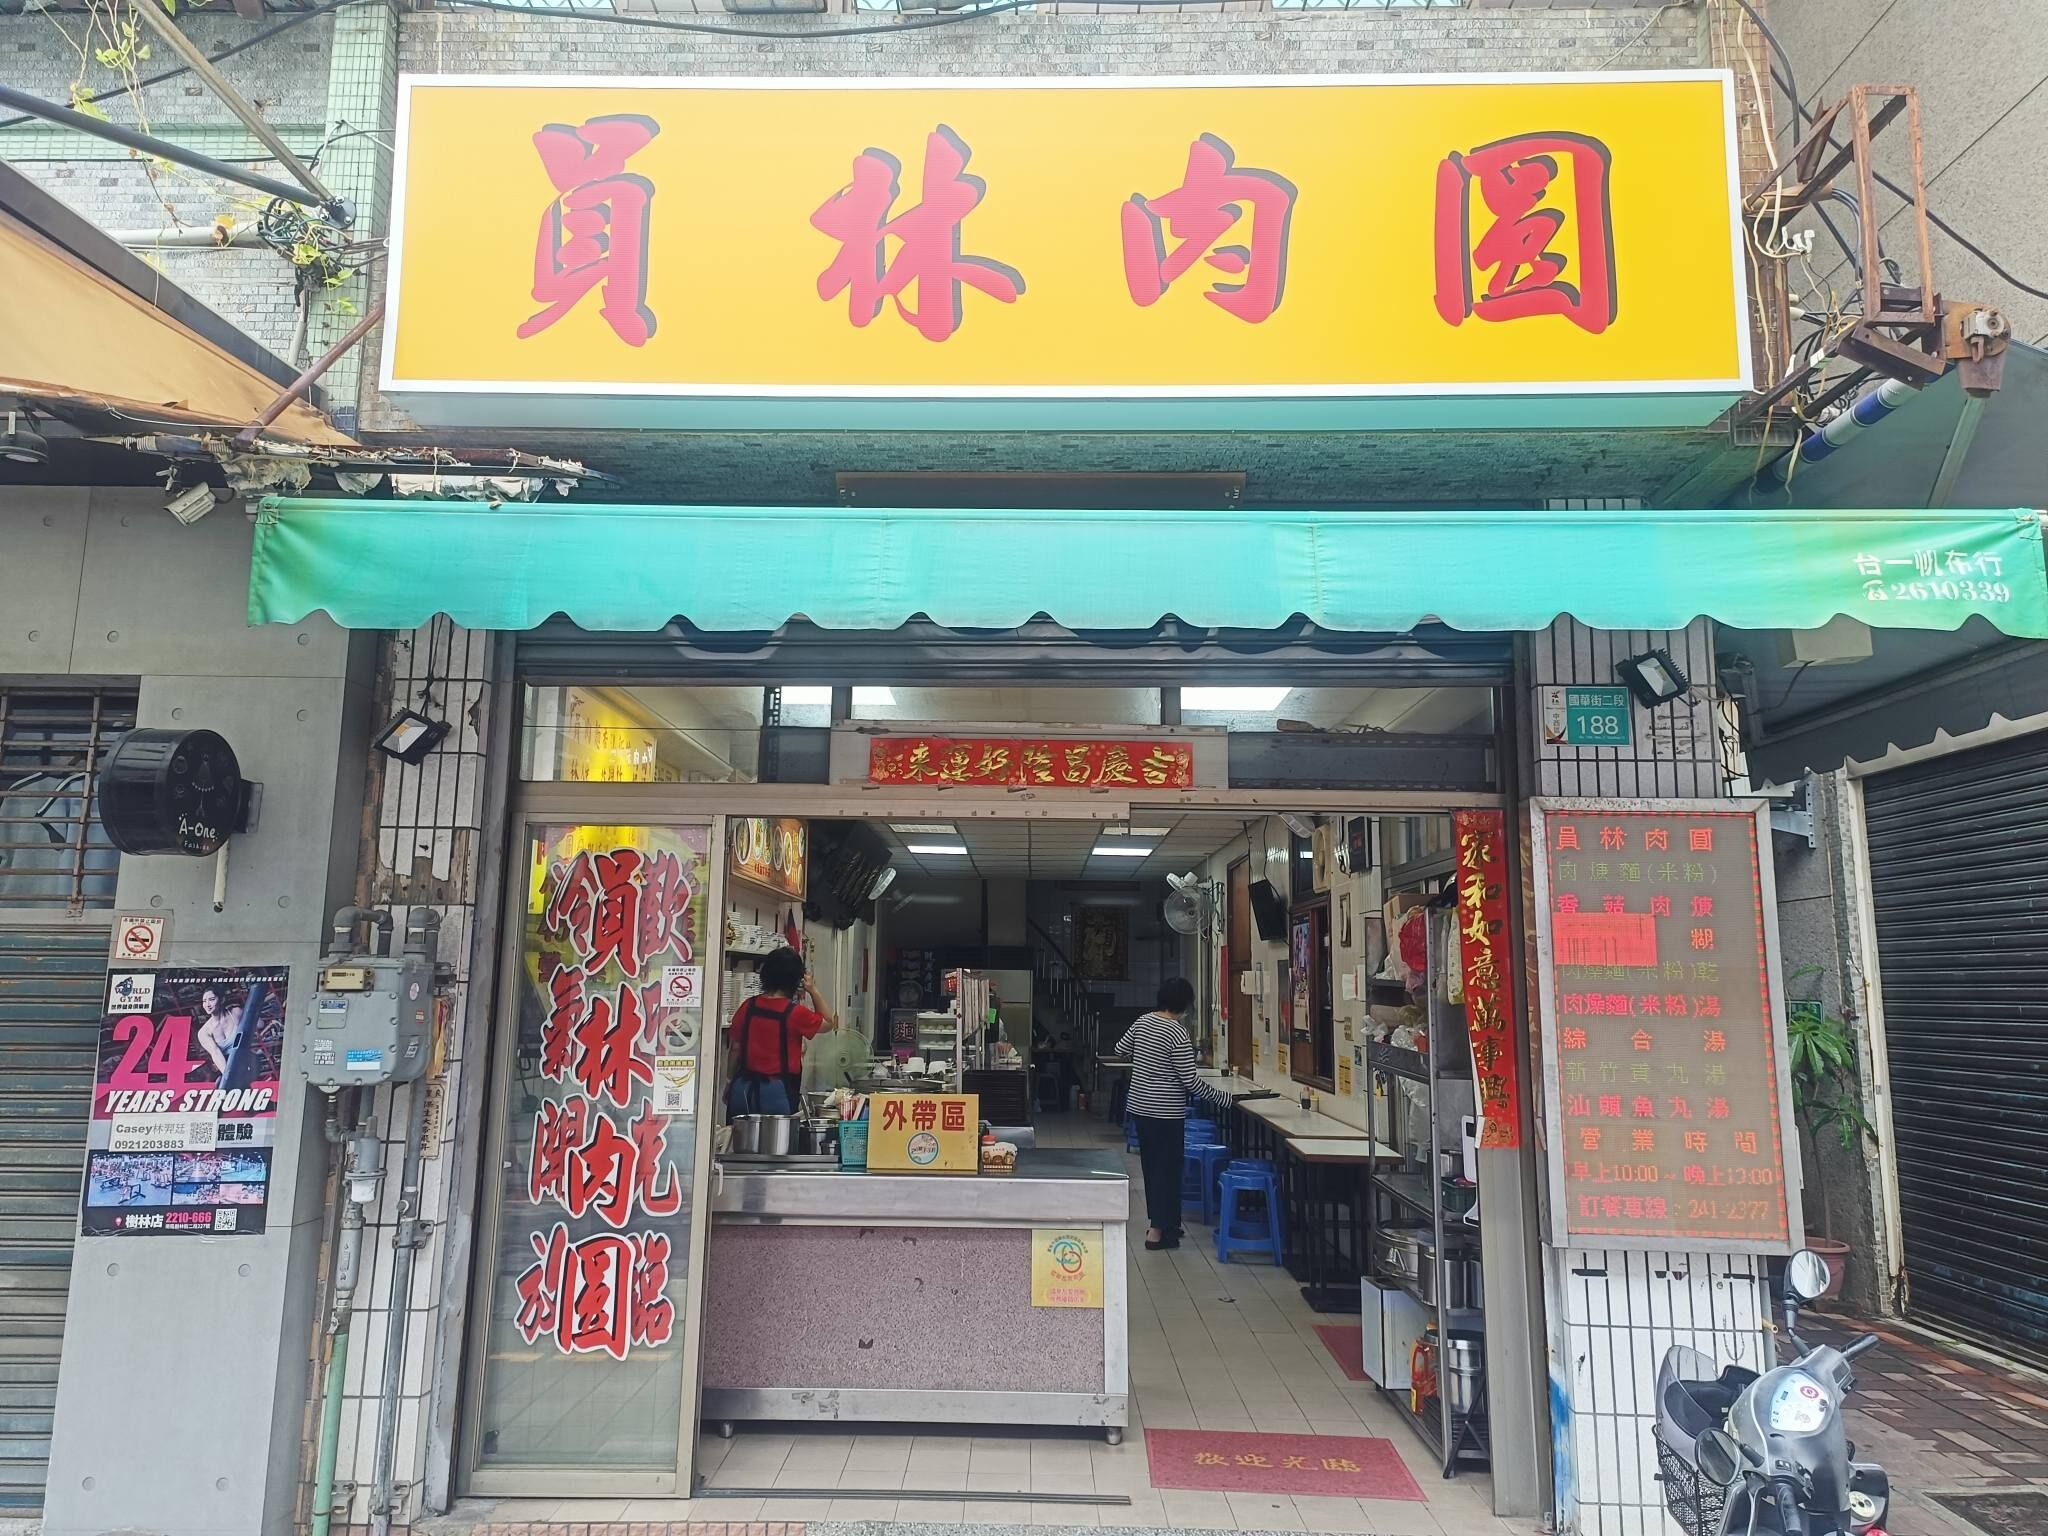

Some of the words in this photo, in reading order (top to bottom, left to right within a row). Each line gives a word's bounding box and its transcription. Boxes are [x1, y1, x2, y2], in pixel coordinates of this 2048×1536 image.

[1891, 580, 2010, 602] 2610339
[1568, 694, 1625, 707] 國華街二段
[1577, 715, 1619, 735] 188
[110, 1016, 206, 1085] 24
[105, 1089, 176, 1113] YEARS
[179, 1087, 272, 1112] STRONG
[882, 1099, 966, 1131] 外帶區
[217, 1123, 253, 1141] 體驗
[1580, 1127, 1757, 1154] 營業時間
[114, 1139, 184, 1150] 0921203883
[125, 1214, 163, 1228] 樹林店
[165, 1212, 212, 1223] 2210-666
[1193, 1452, 1361, 1473] 歡迎光臨
